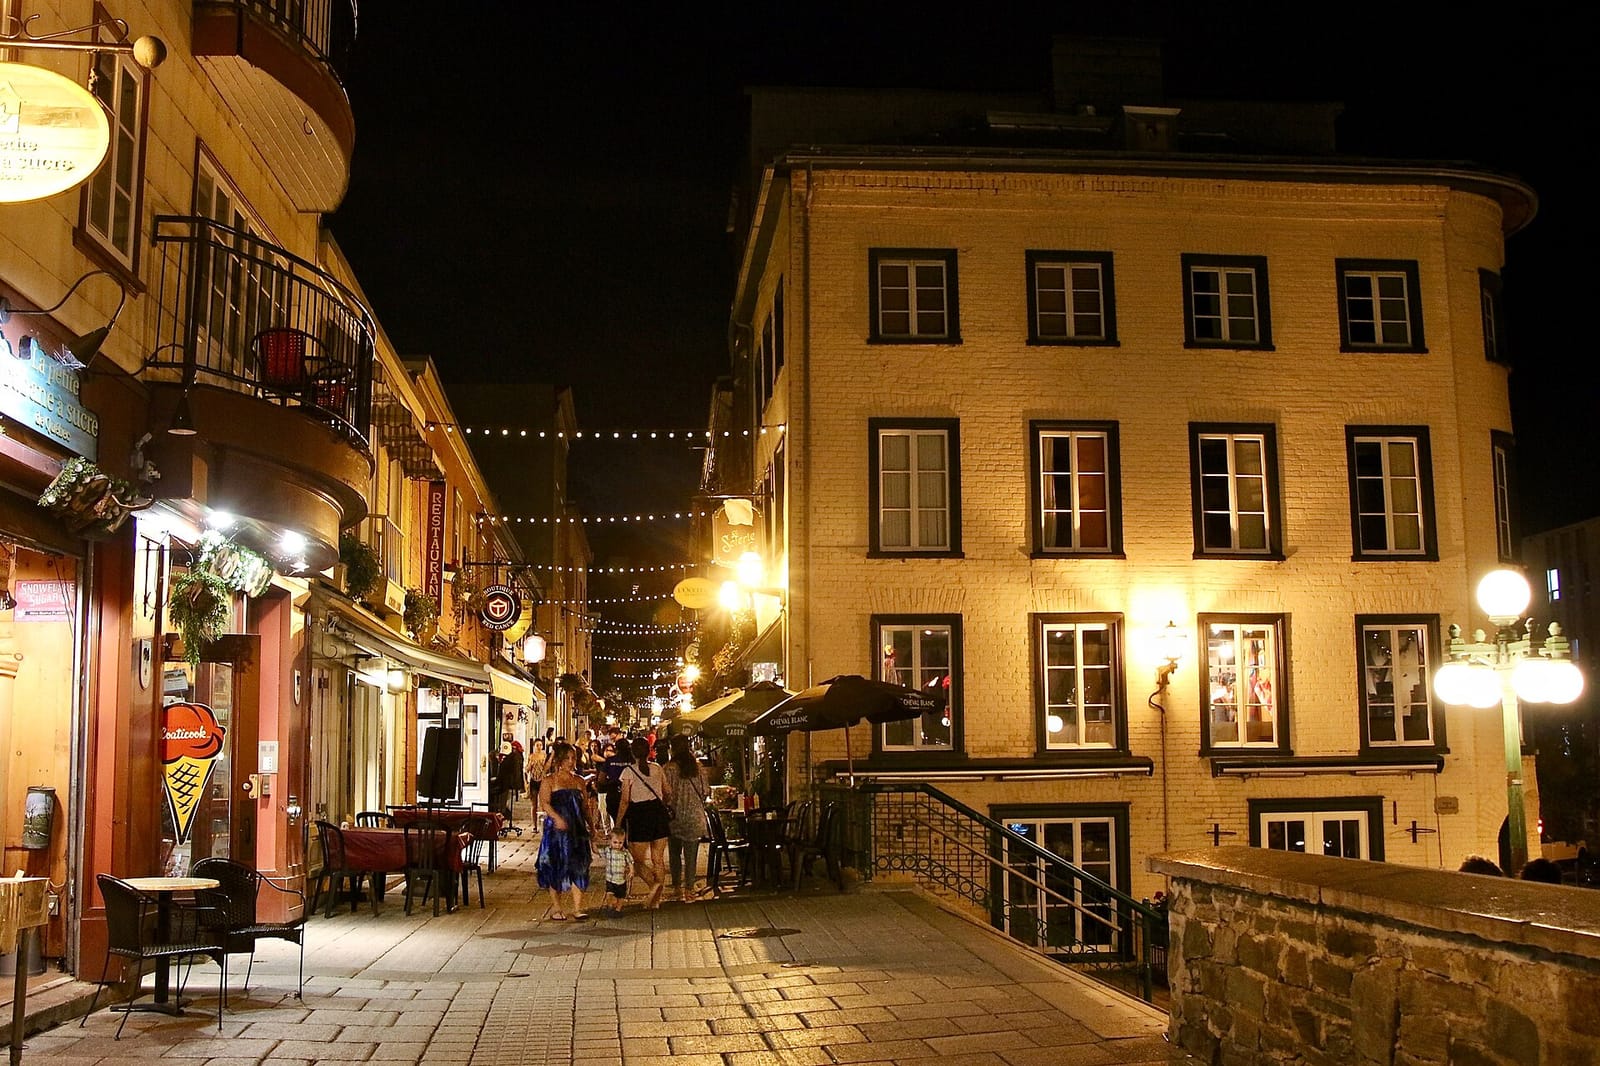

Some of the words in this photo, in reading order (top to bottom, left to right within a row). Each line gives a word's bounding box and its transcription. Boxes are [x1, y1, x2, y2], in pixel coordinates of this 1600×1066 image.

[32, 347, 46, 374] La
[57, 396, 64, 419] à
[66, 402, 99, 438] sucre
[769, 718, 790, 727] CHEVAL
[791, 715, 808, 724] BLANC
